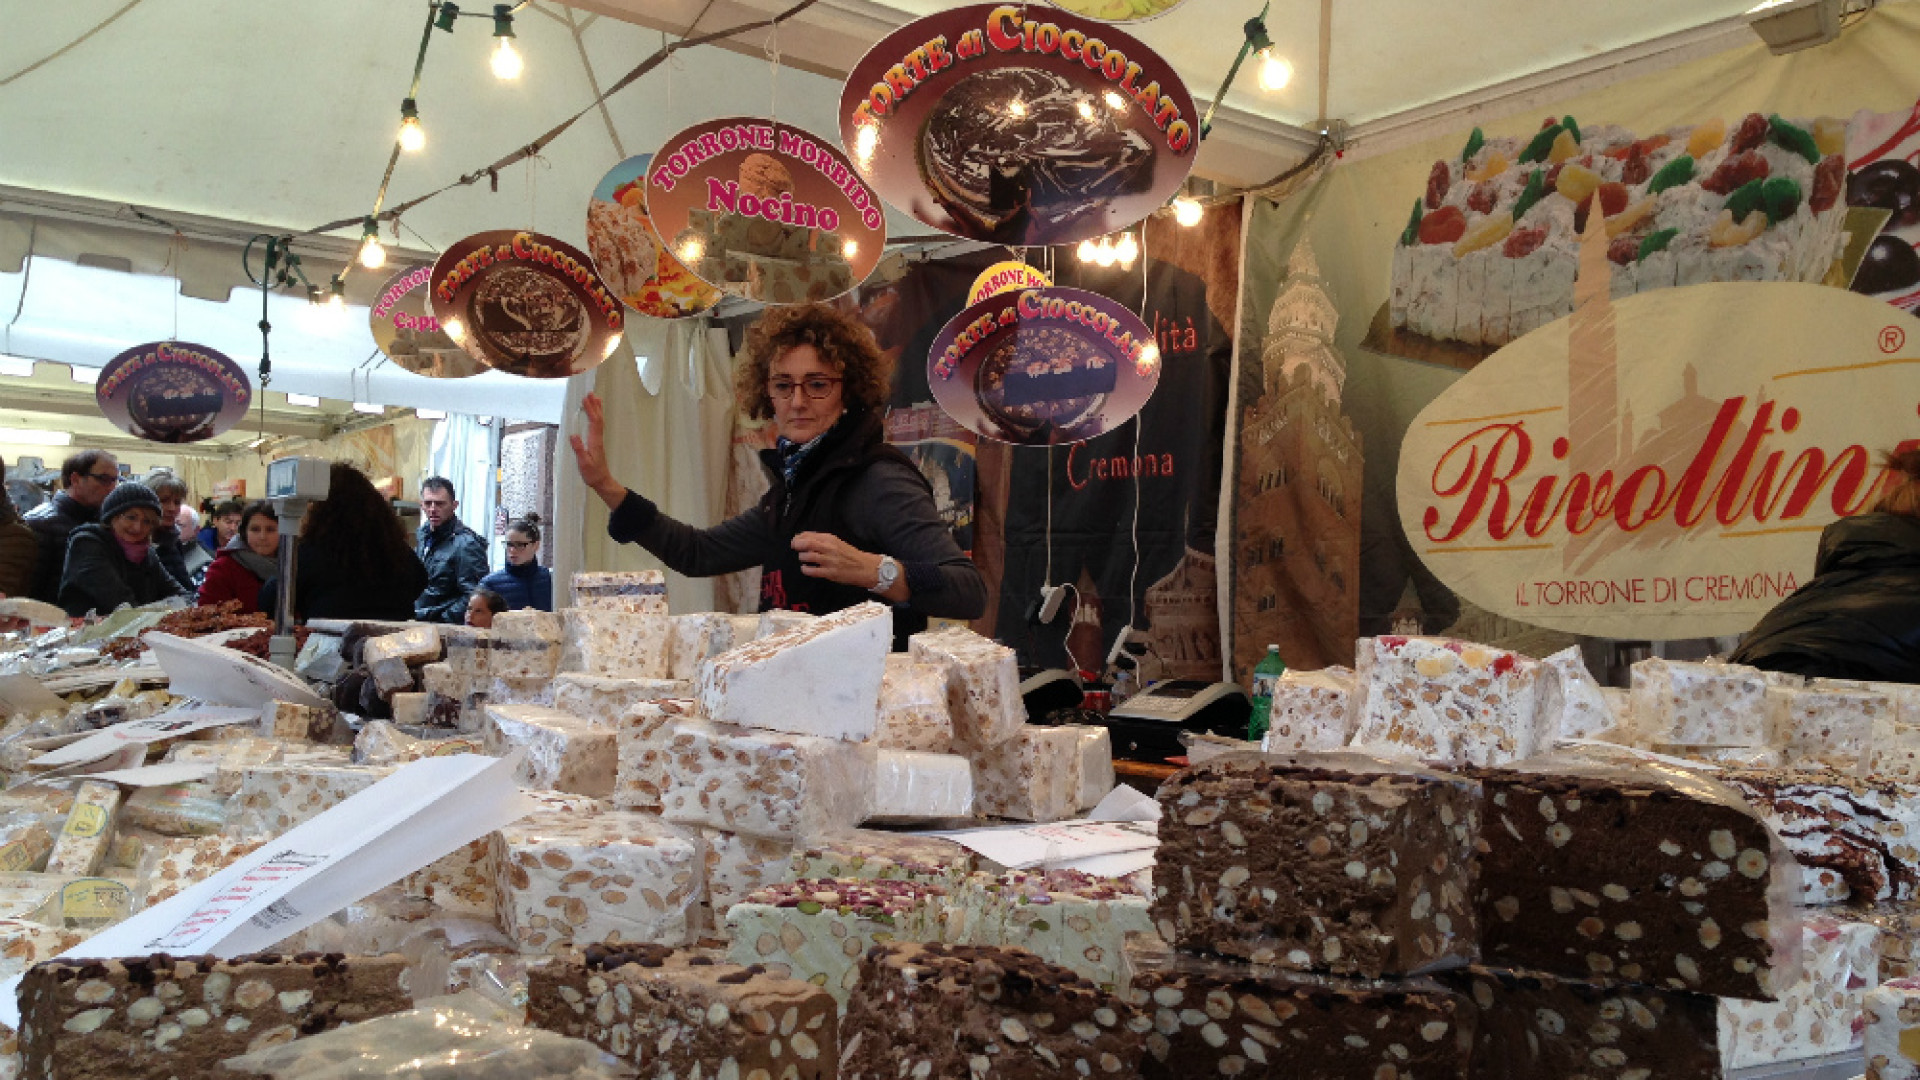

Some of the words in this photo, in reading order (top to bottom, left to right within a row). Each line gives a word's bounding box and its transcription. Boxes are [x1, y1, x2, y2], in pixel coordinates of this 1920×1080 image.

[853, 34, 952, 127] TORTE
[955, 28, 985, 60] di
[652, 124, 776, 193] TORRONE
[778, 129, 882, 231] MORBIDO
[705, 176, 840, 231] Nocino
[436, 244, 495, 303] TORTE
[972, 269, 1024, 304] ORRONE
[934, 313, 997, 381] TORTE
[100, 355, 142, 399] TORTE
[1066, 440, 1175, 492] Cremona
[1515, 581, 1529, 607] IL
[1534, 578, 1646, 606] TORRONE
[1652, 577, 1677, 603] DI
[1684, 571, 1798, 602] CREMONA
